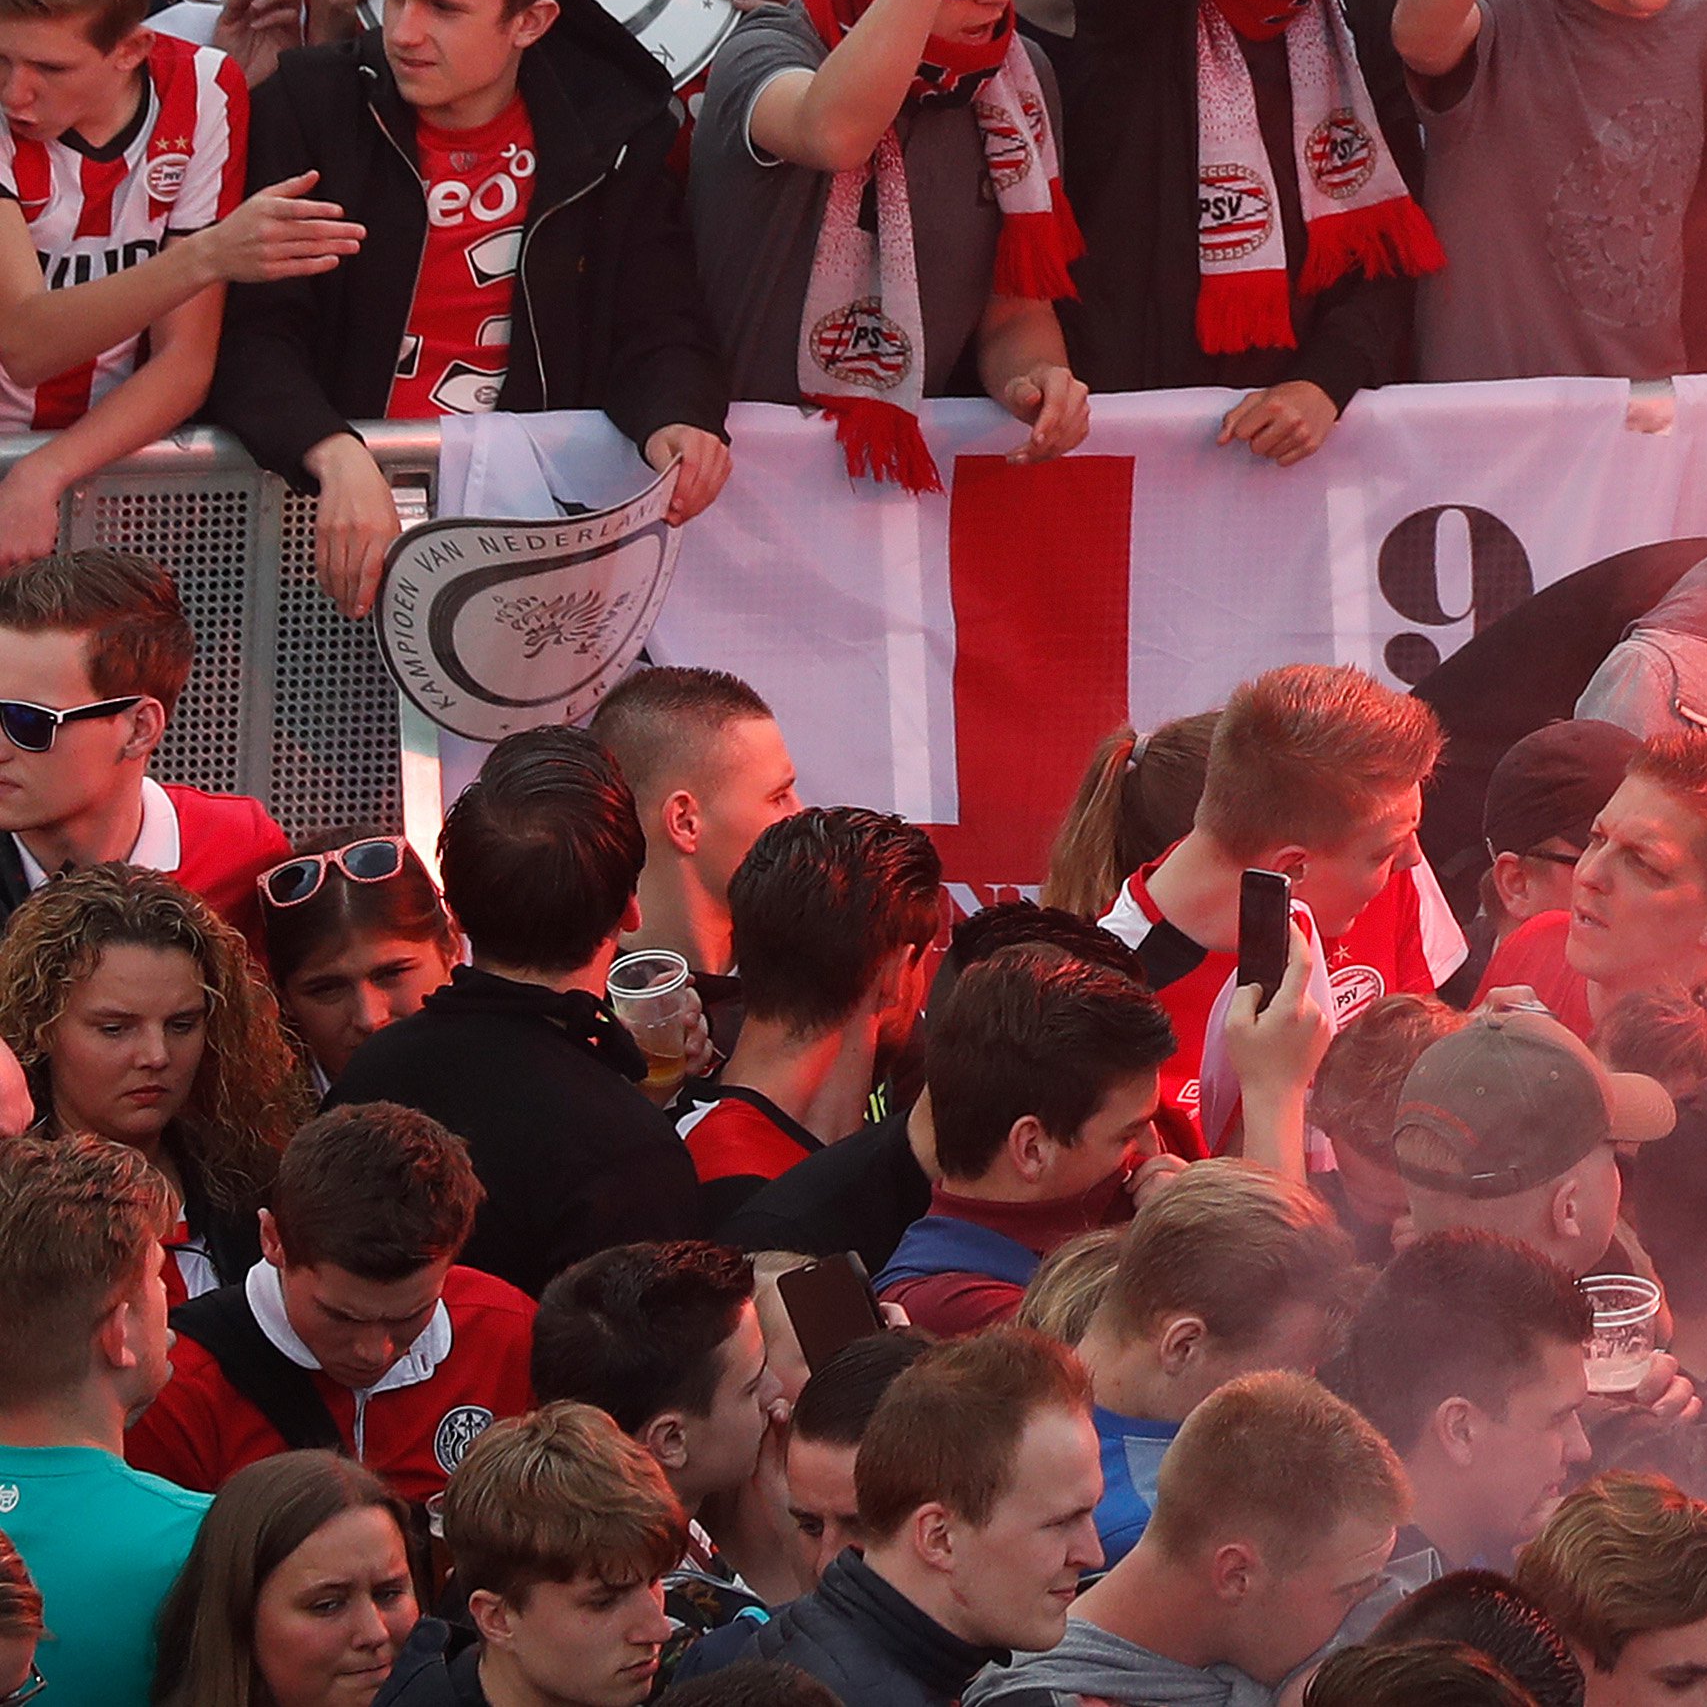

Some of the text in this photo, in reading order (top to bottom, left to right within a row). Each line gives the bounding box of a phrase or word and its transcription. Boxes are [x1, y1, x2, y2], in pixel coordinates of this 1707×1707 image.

[161, 168, 183, 183] PSV
[385, 494, 664, 712] KAMPIOEN VAN NEDERLAN
[1335, 987, 1360, 1010] PSV
